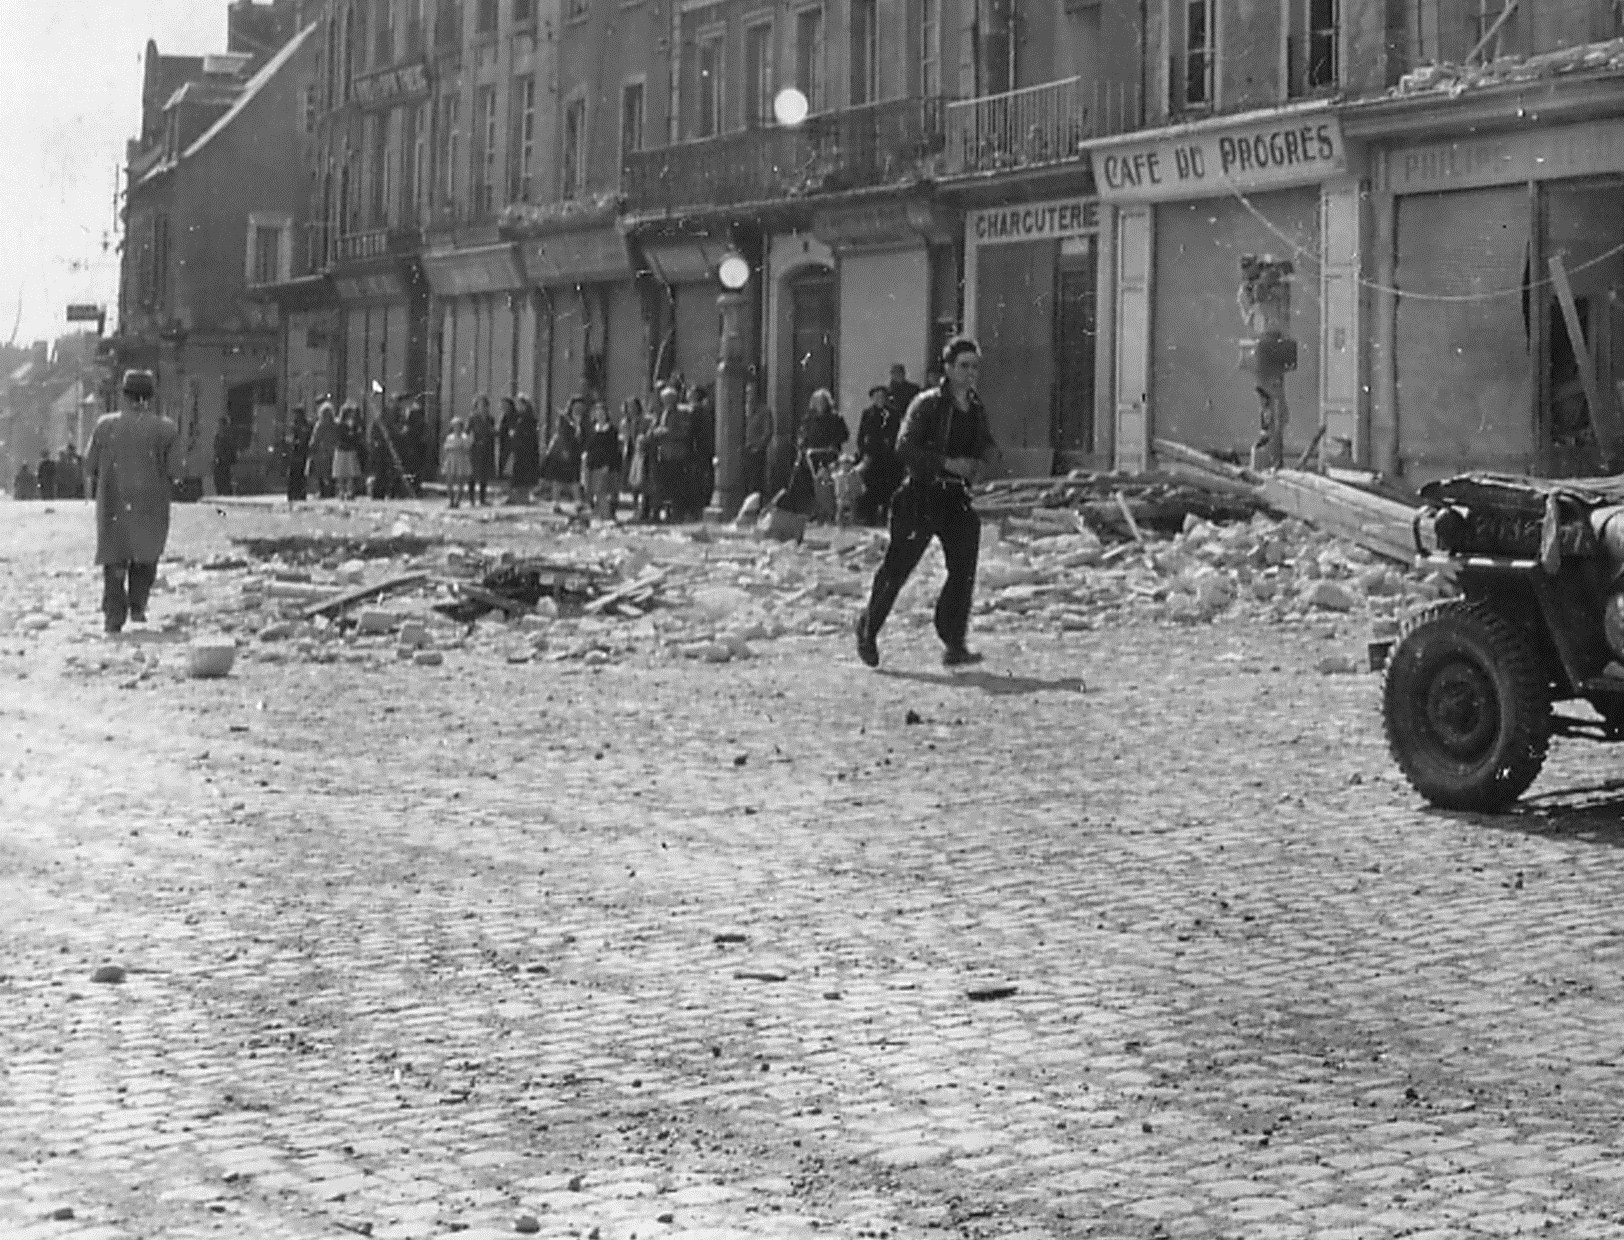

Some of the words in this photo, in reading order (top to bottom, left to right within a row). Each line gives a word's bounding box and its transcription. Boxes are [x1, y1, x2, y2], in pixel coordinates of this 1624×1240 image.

[1104, 152, 1161, 189] CAFE
[1178, 142, 1205, 180] DU
[976, 201, 1100, 239] CHARCUTERIE
